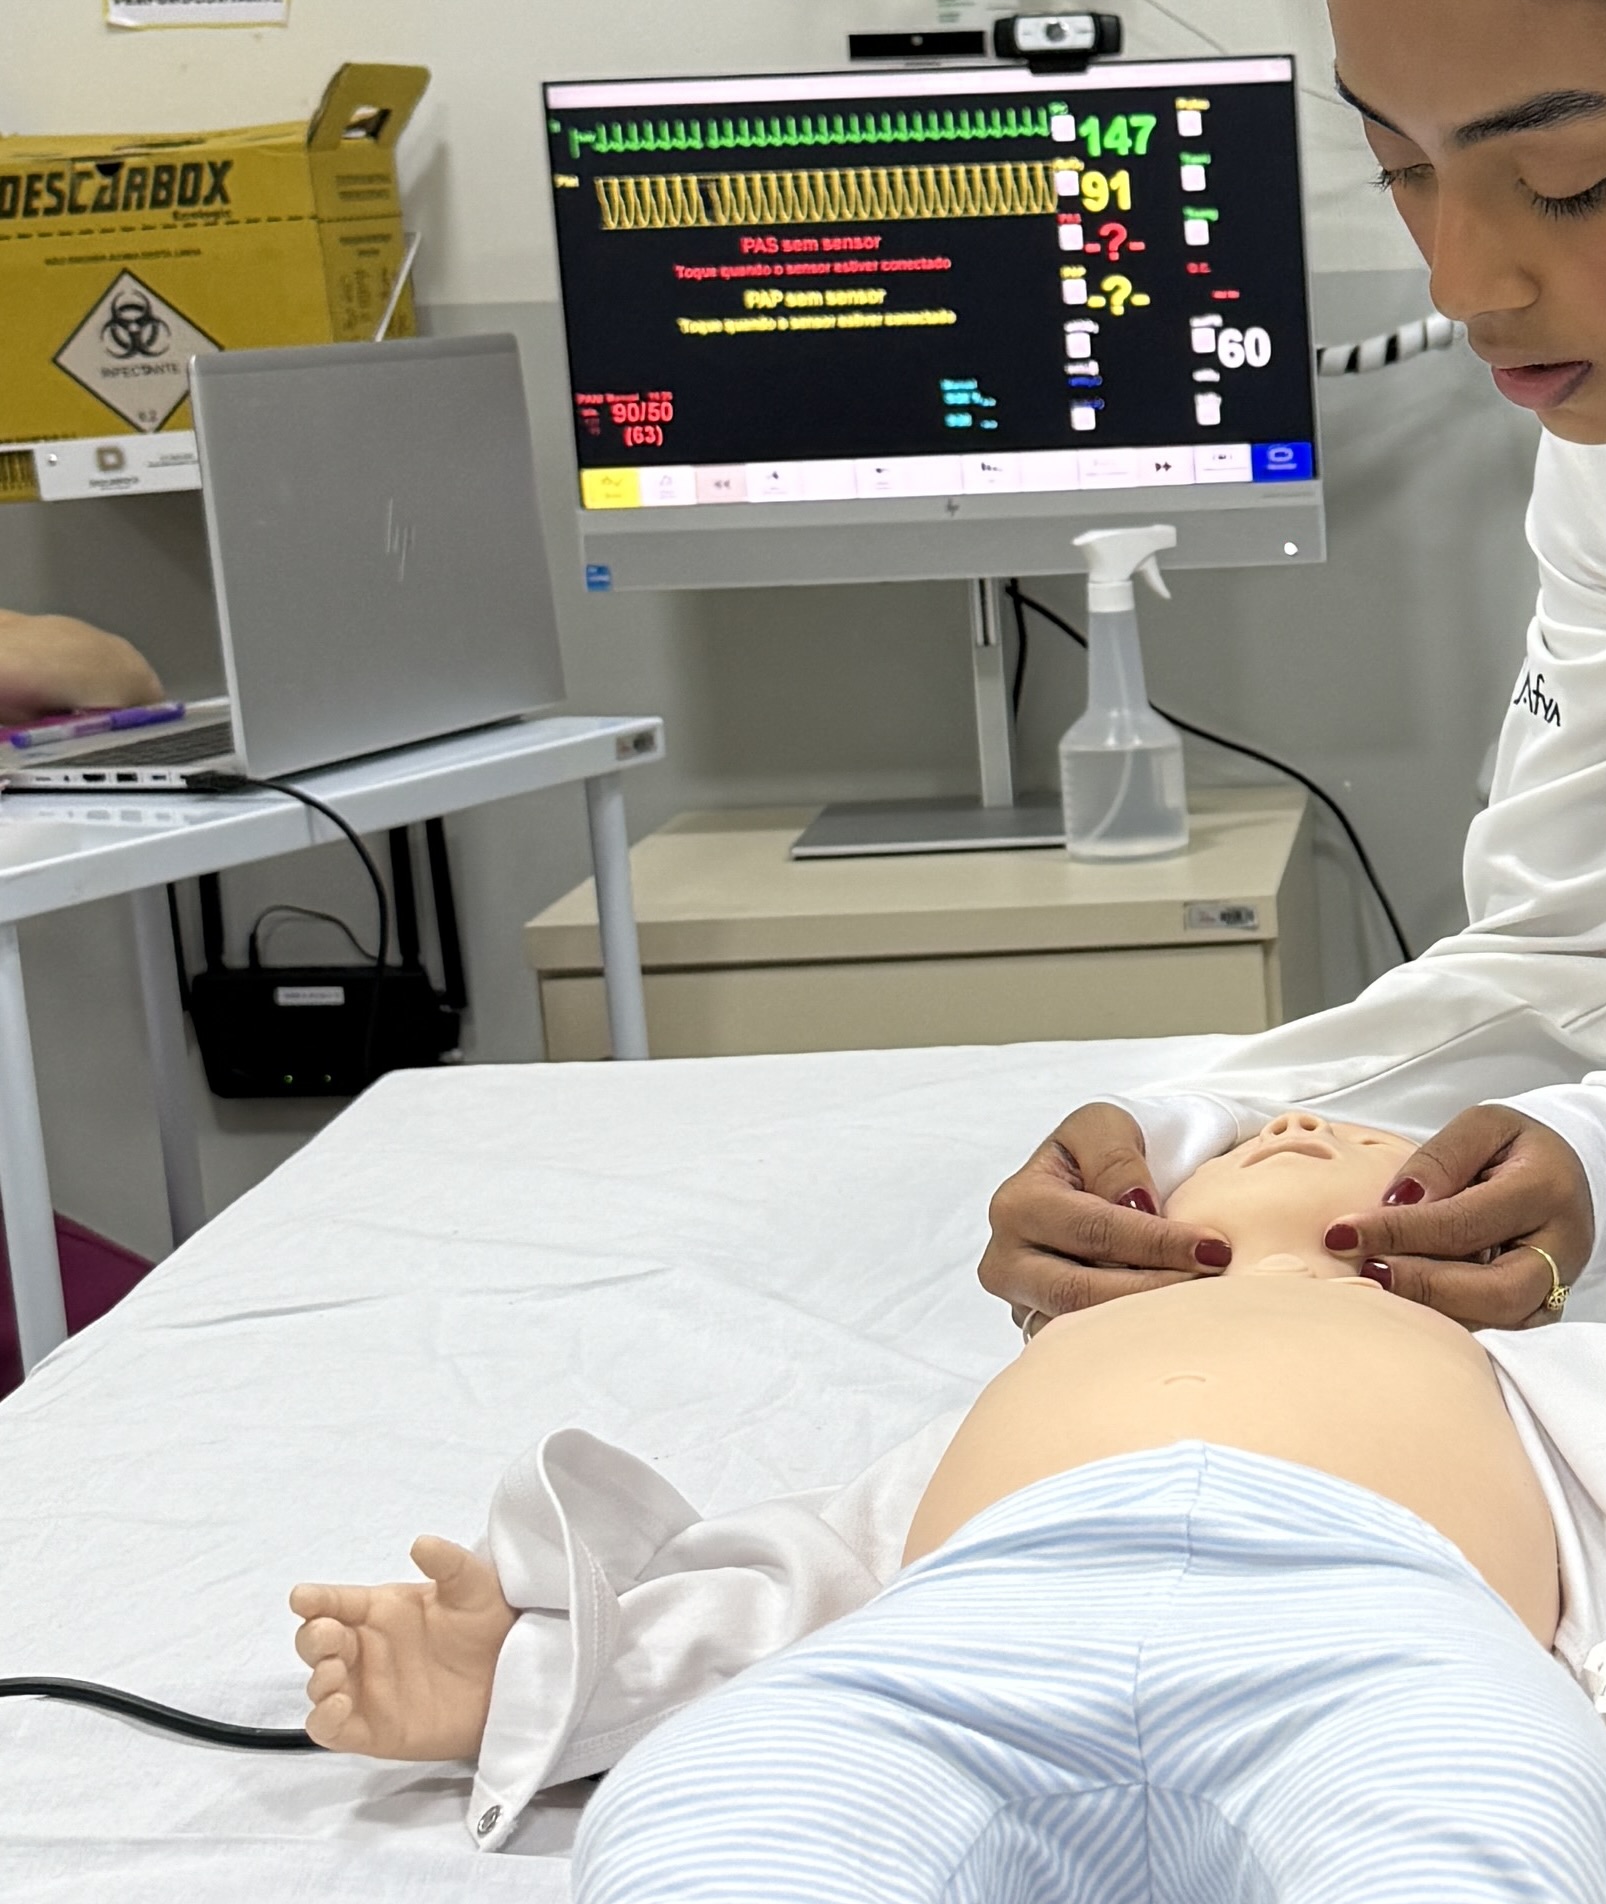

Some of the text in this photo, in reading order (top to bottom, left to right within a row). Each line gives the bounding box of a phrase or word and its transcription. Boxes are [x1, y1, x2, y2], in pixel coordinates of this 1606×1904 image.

[1079, 114, 1157, 156] 147
[1081, 169, 1132, 212] 91
[740, 235, 882, 254] PAS sem sensor
[673, 262, 717, 280] Toque
[720, 262, 772, 280] quando
[785, 261, 831, 275] sensor
[880, 256, 952, 272] conectado
[743, 288, 888, 309] PAP sem sensor
[1217, 326, 1272, 368] 60
[611, 400, 674, 424] 90/50
[624, 424, 664, 446] (63)
